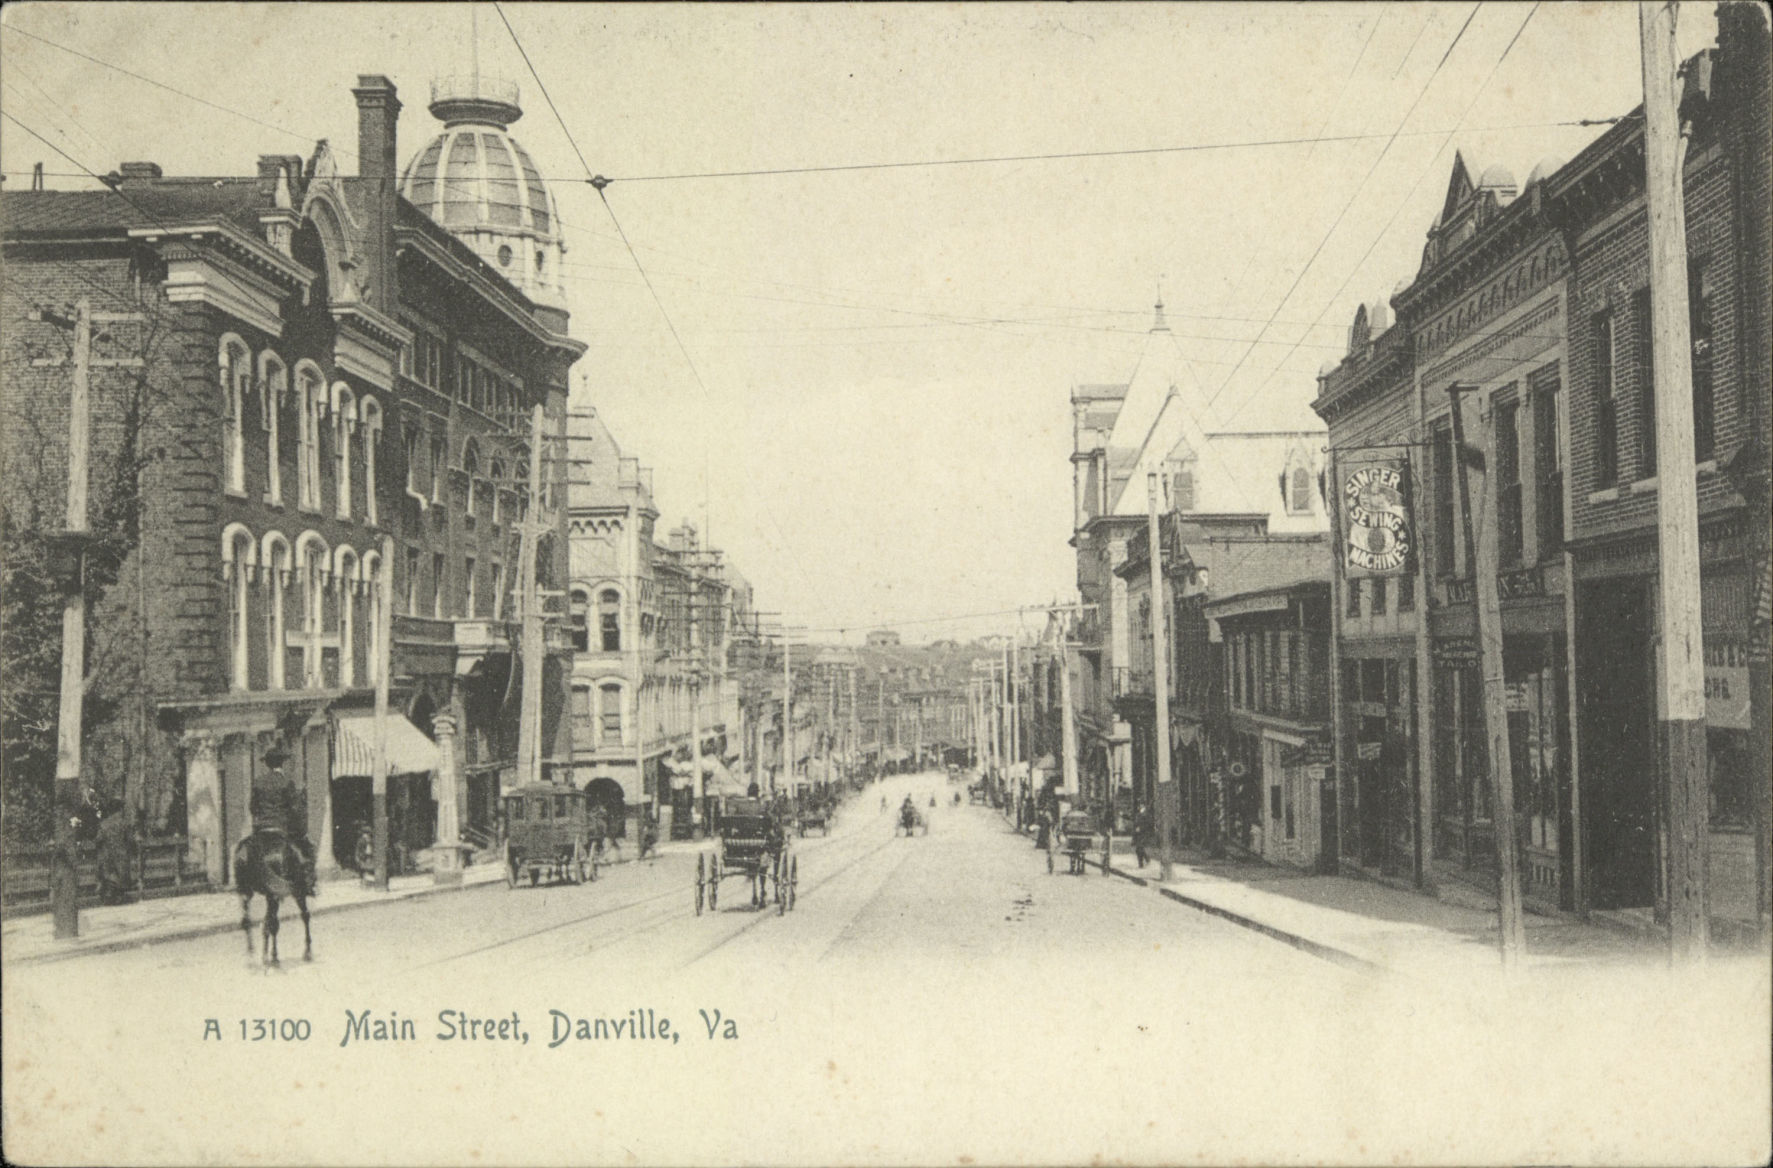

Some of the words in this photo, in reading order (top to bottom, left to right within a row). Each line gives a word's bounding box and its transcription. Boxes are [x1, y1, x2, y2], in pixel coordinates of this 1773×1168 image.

[1346, 469, 1400, 497] SINGER
[1350, 506, 1402, 531] SEWING
[1349, 541, 1409, 569] MACHINES
